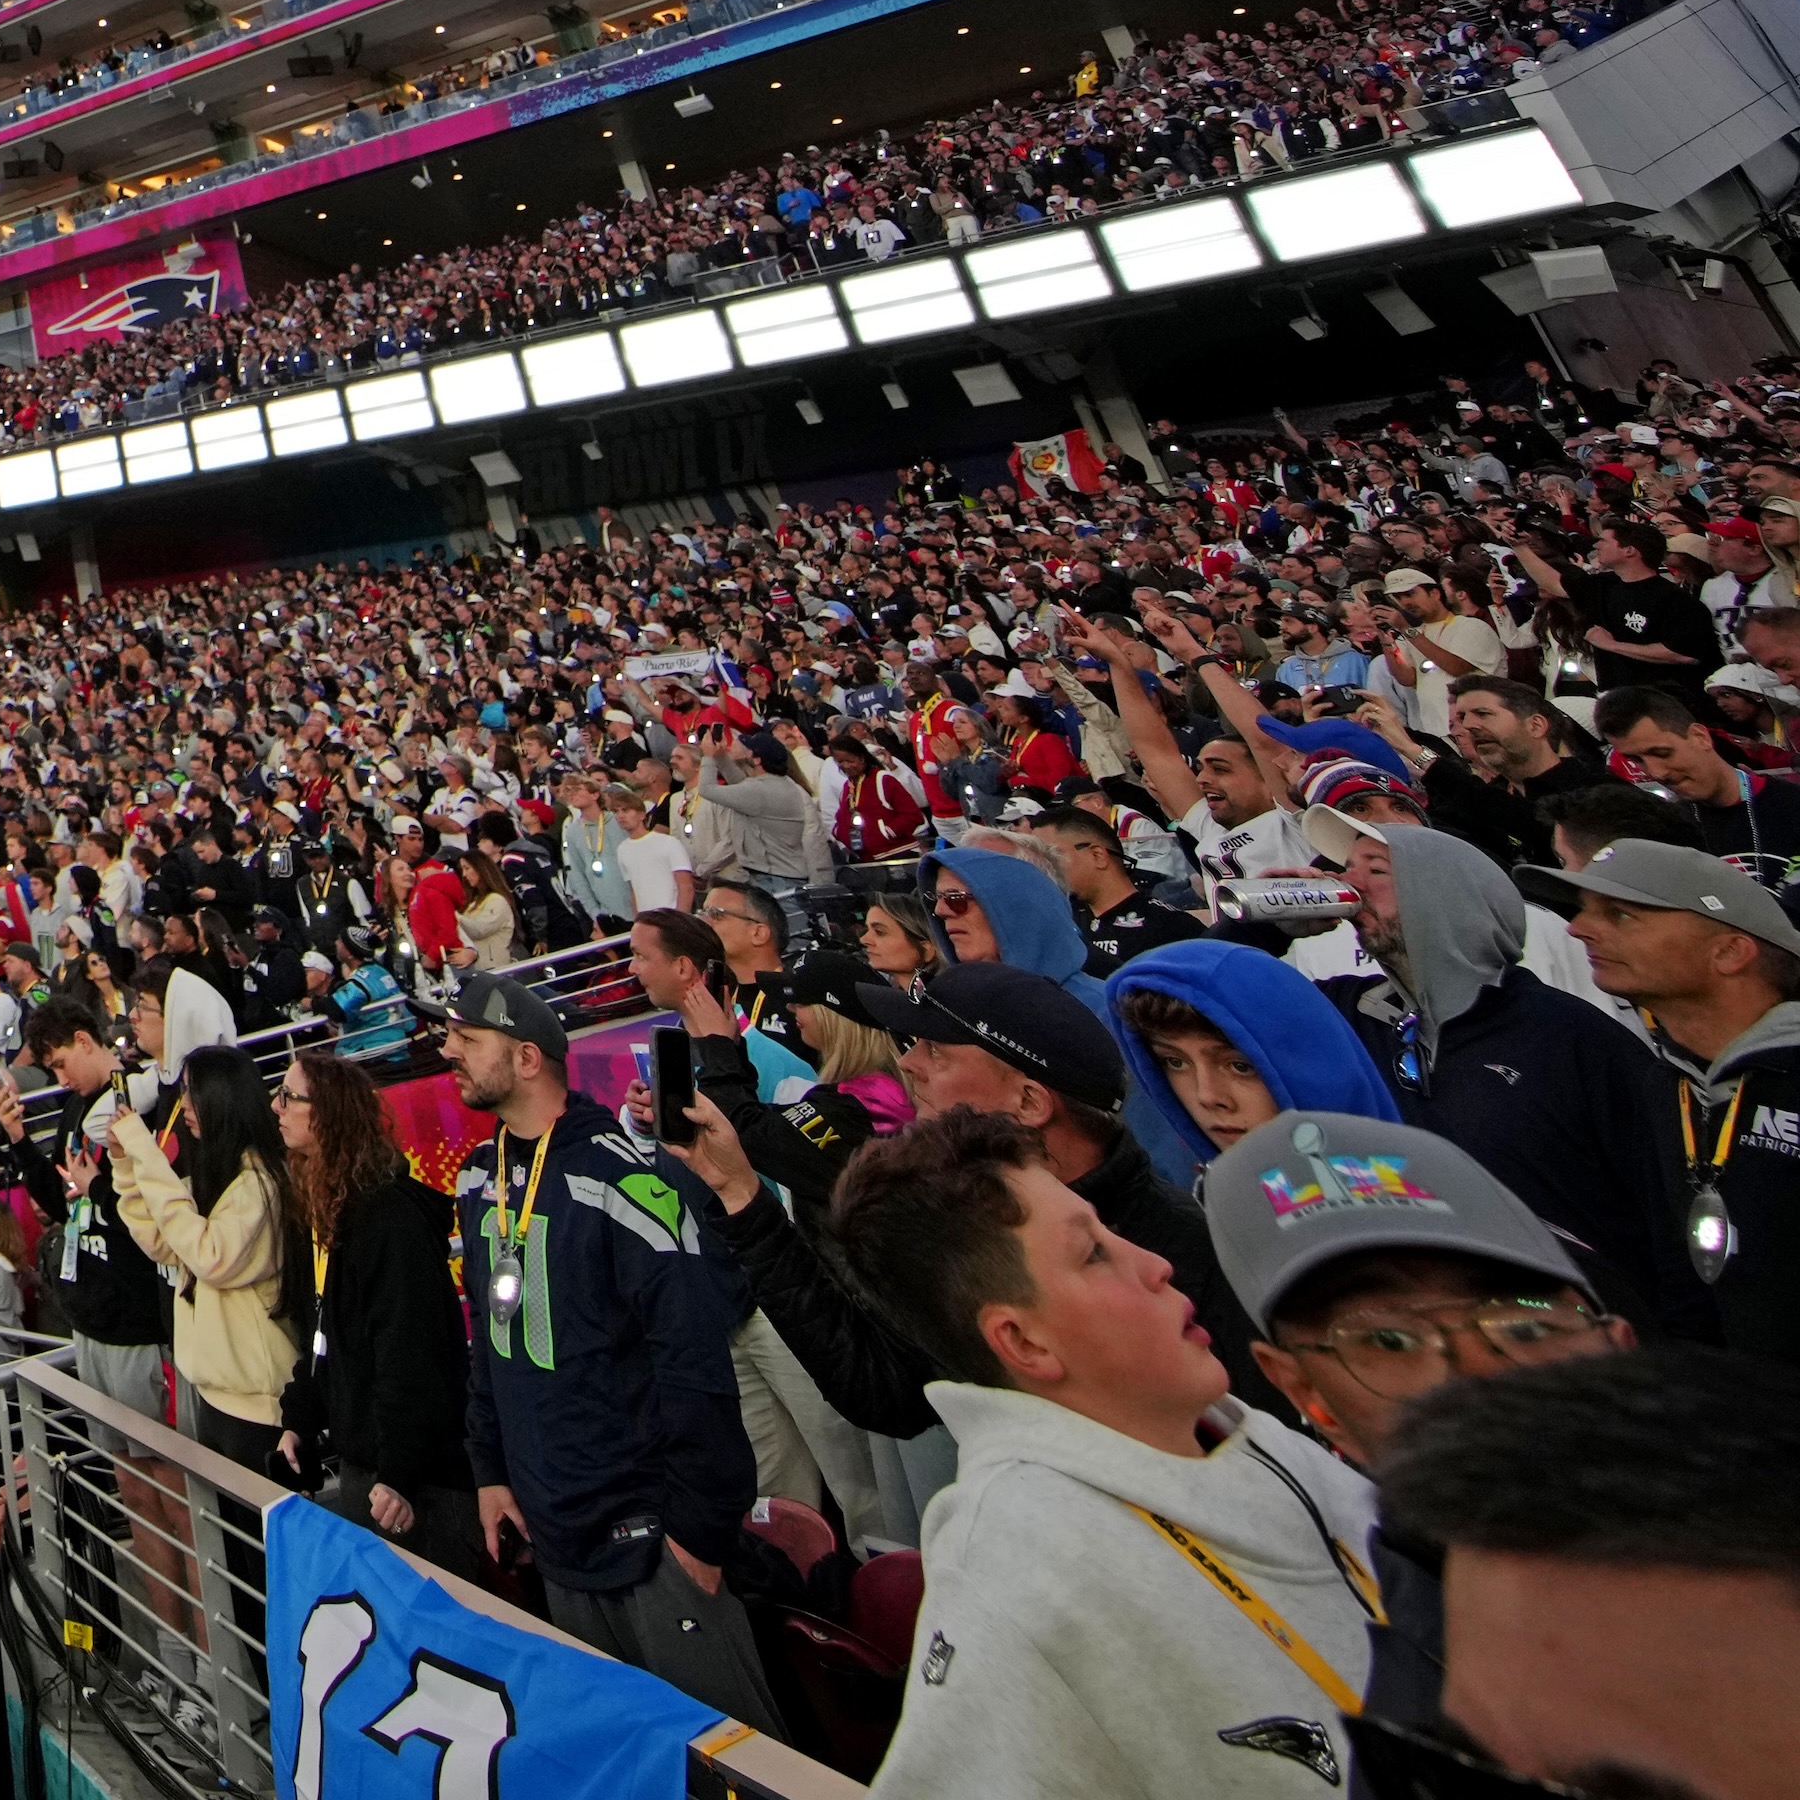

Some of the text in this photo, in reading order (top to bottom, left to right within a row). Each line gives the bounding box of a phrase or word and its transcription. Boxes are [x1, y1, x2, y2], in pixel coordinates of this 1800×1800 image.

[641, 656, 700, 673] Puerto Rico
[1263, 889, 1332, 908] ULTRA
[1265, 878, 1308, 892] Michelob
[798, 1113, 844, 1151] LX
[1738, 1132, 1800, 1161] PATRIOT
[590, 1131, 655, 1169] 11
[1187, 1545, 1252, 1603] BUNNY
